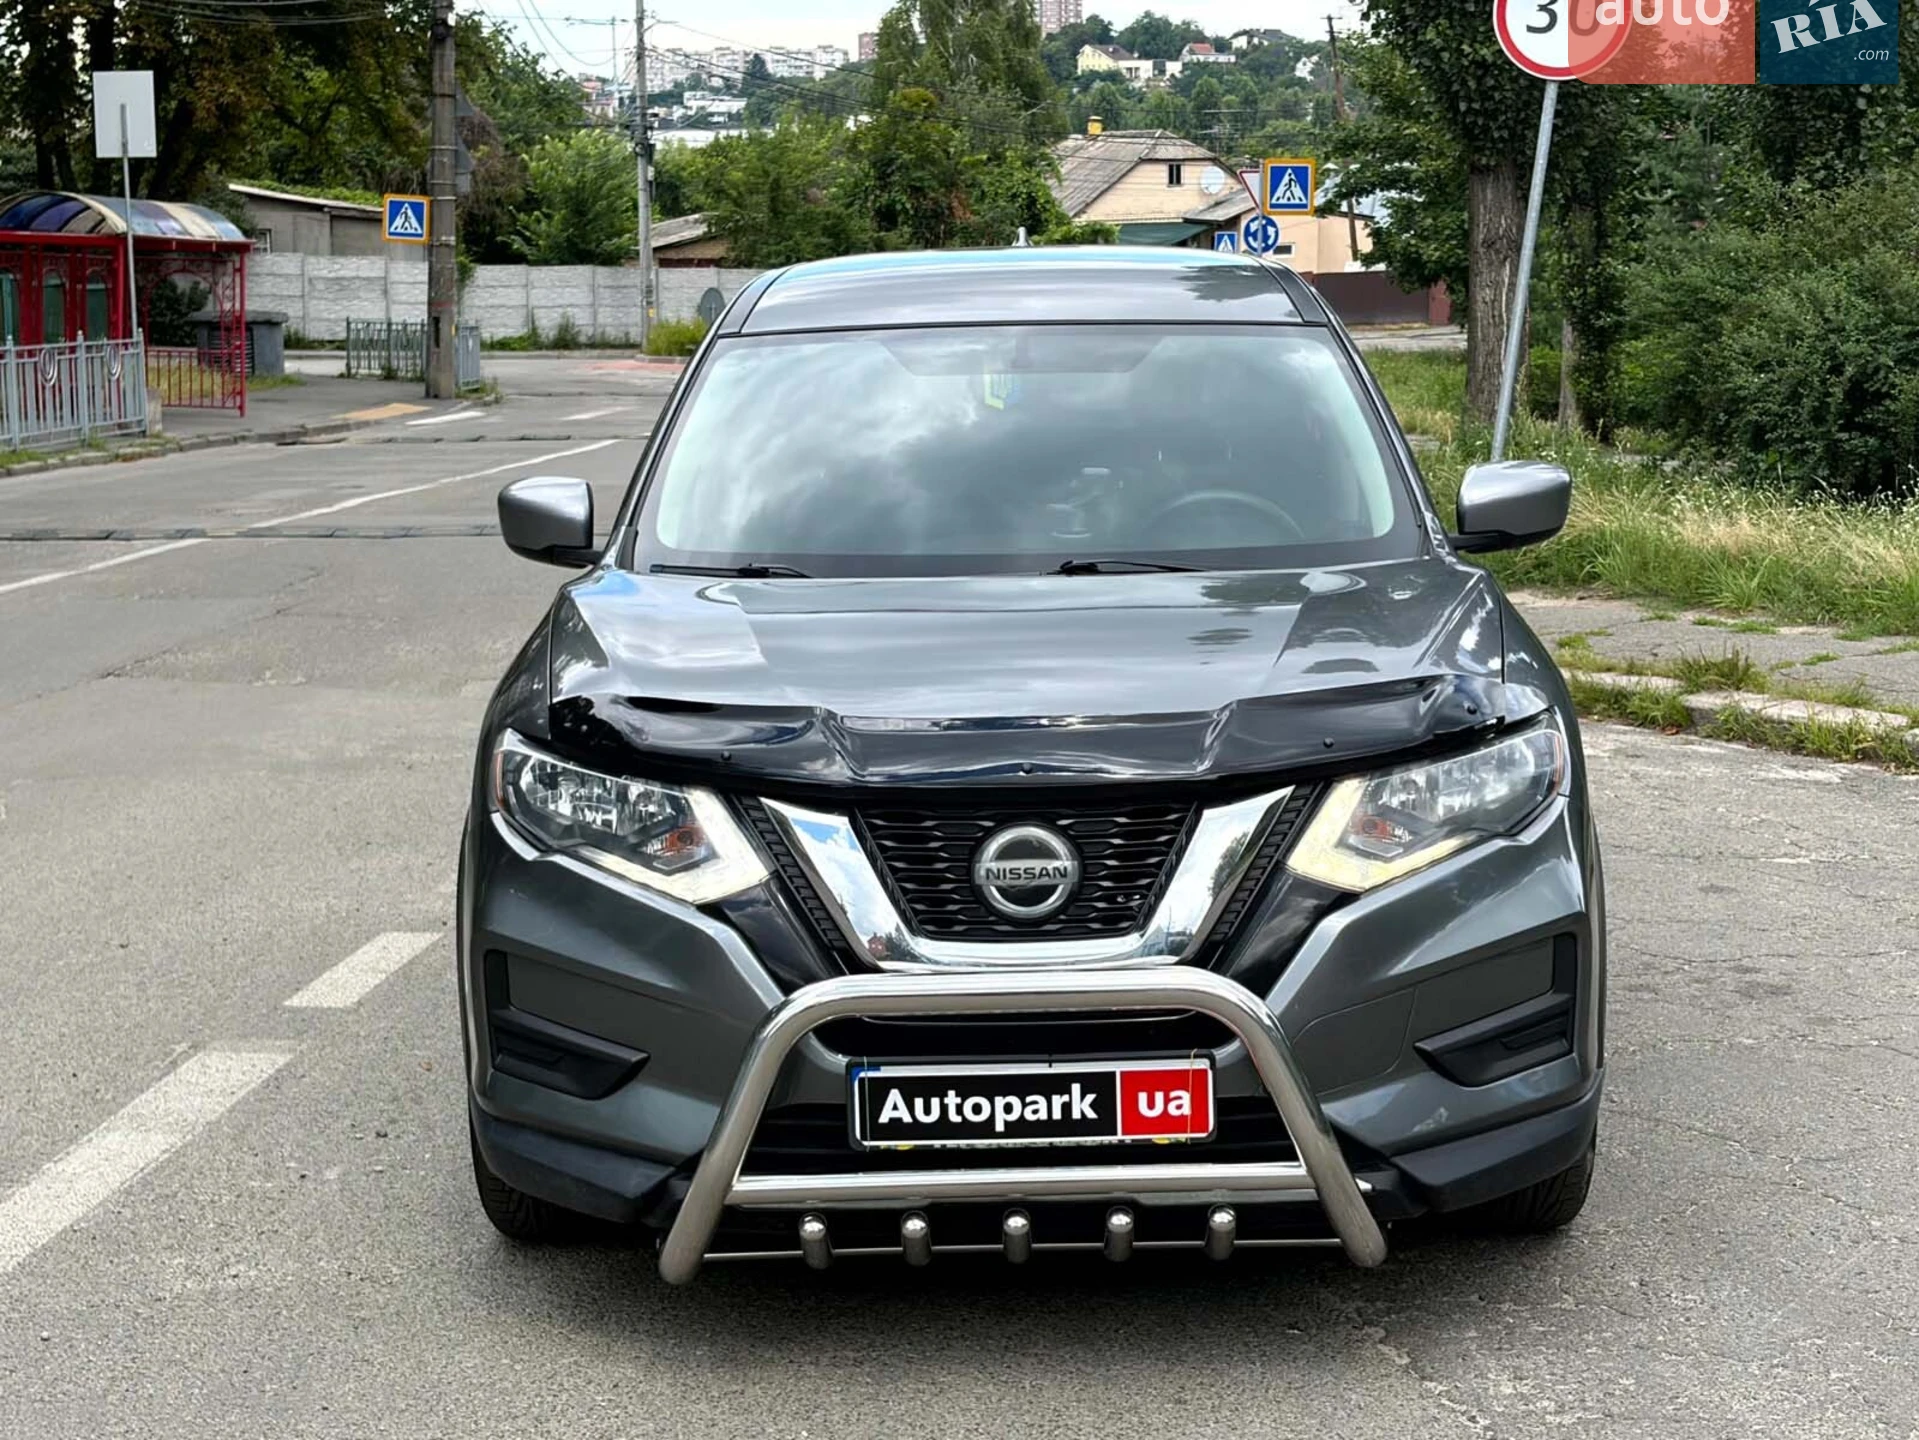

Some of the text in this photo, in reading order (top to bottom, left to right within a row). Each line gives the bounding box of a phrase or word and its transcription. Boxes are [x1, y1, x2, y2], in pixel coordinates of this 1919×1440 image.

[985, 866, 1068, 881] NISSAN
[878, 1083, 1192, 1132] Autopark ua
